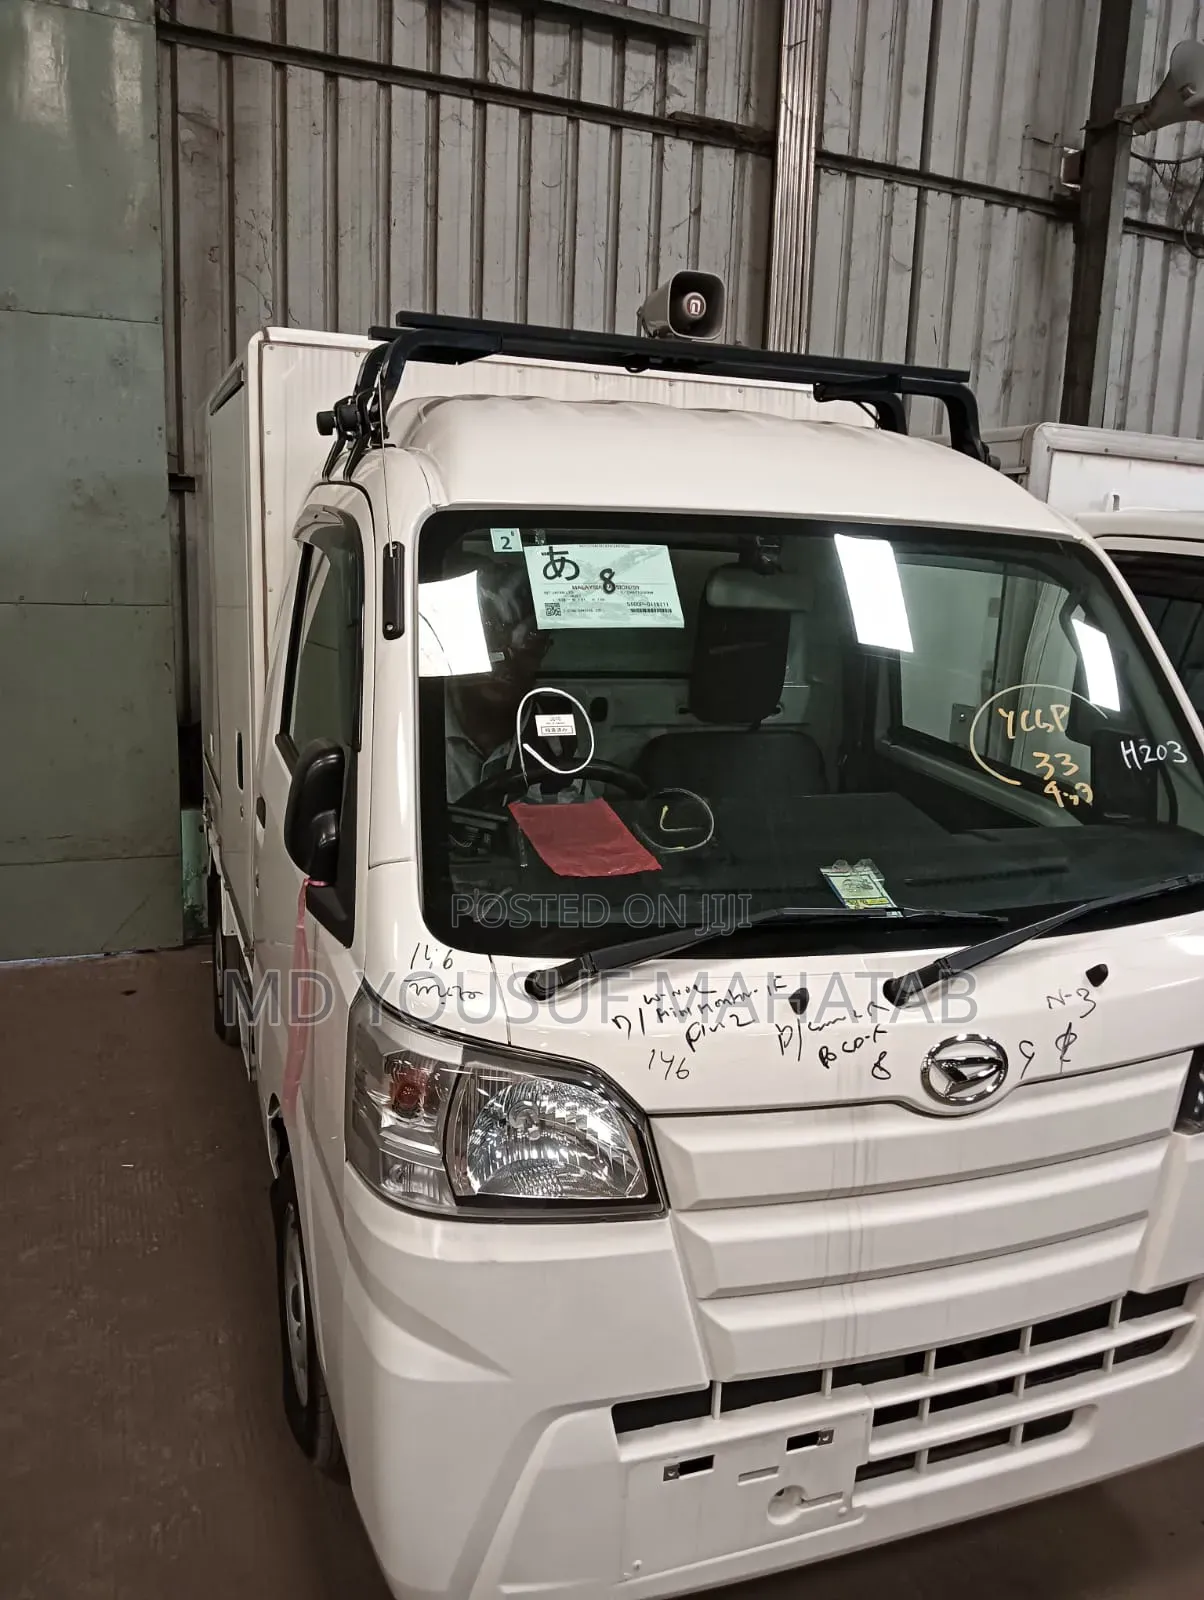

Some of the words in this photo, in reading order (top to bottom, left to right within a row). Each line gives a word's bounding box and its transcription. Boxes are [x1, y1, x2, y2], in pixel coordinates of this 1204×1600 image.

[500, 535, 513, 550] 2
[541, 546, 580, 581] あ
[599, 568, 616, 594] 8
[1032, 751, 1080, 781] 33
[1120, 739, 1188, 771] H203
